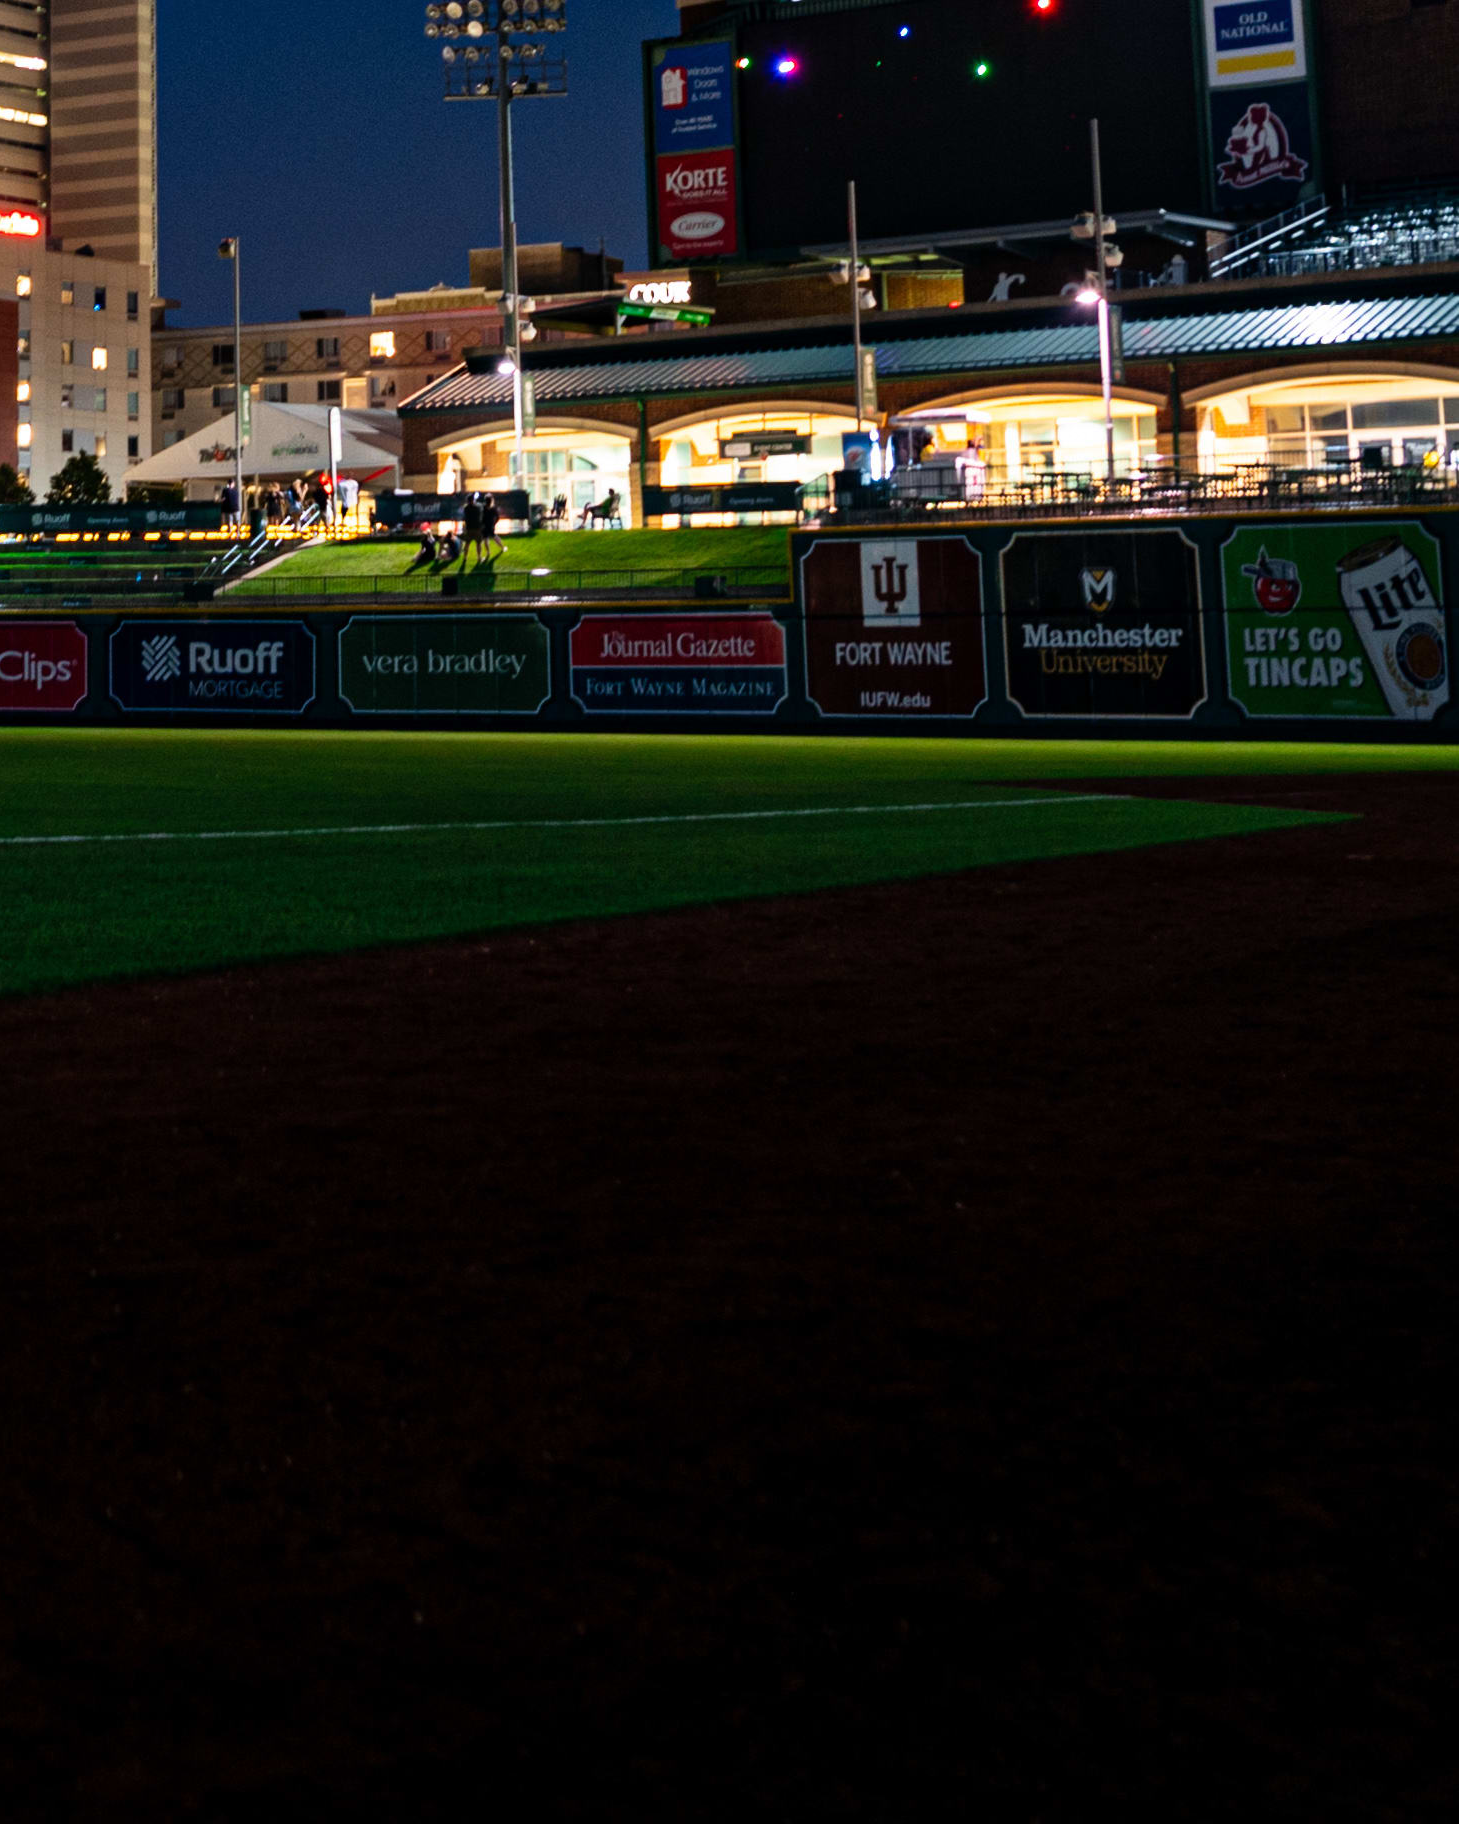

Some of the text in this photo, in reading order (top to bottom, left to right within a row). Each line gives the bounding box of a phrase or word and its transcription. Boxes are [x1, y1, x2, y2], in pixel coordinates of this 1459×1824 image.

[1221, 20, 1287, 40] NATIONAL
[1238, 11, 1268, 26] OLD
[665, 164, 729, 195] KORTE
[678, 218, 718, 233] Carrier
[43, 513, 71, 524] Ruoff
[158, 511, 186, 522] Ruoff
[414, 502, 441, 514] Ruoff
[1358, 567, 1426, 632] Lite
[599, 632, 756, 658] Journal Gazette
[1021, 622, 1184, 649] Manchester
[1243, 626, 1343, 653] LET'S GO
[188, 641, 285, 675] Ruoff
[362, 648, 528, 680] vera bradley
[834, 640, 954, 666] FORT WAYNE
[1039, 648, 1169, 680] University
[1243, 657, 1365, 688] TINCAPS
[188, 680, 285, 699] MORTGAGE
[586, 677, 775, 696] FORT WAYNE MAGAZINE
[860, 690, 932, 708] IUFW.edu
